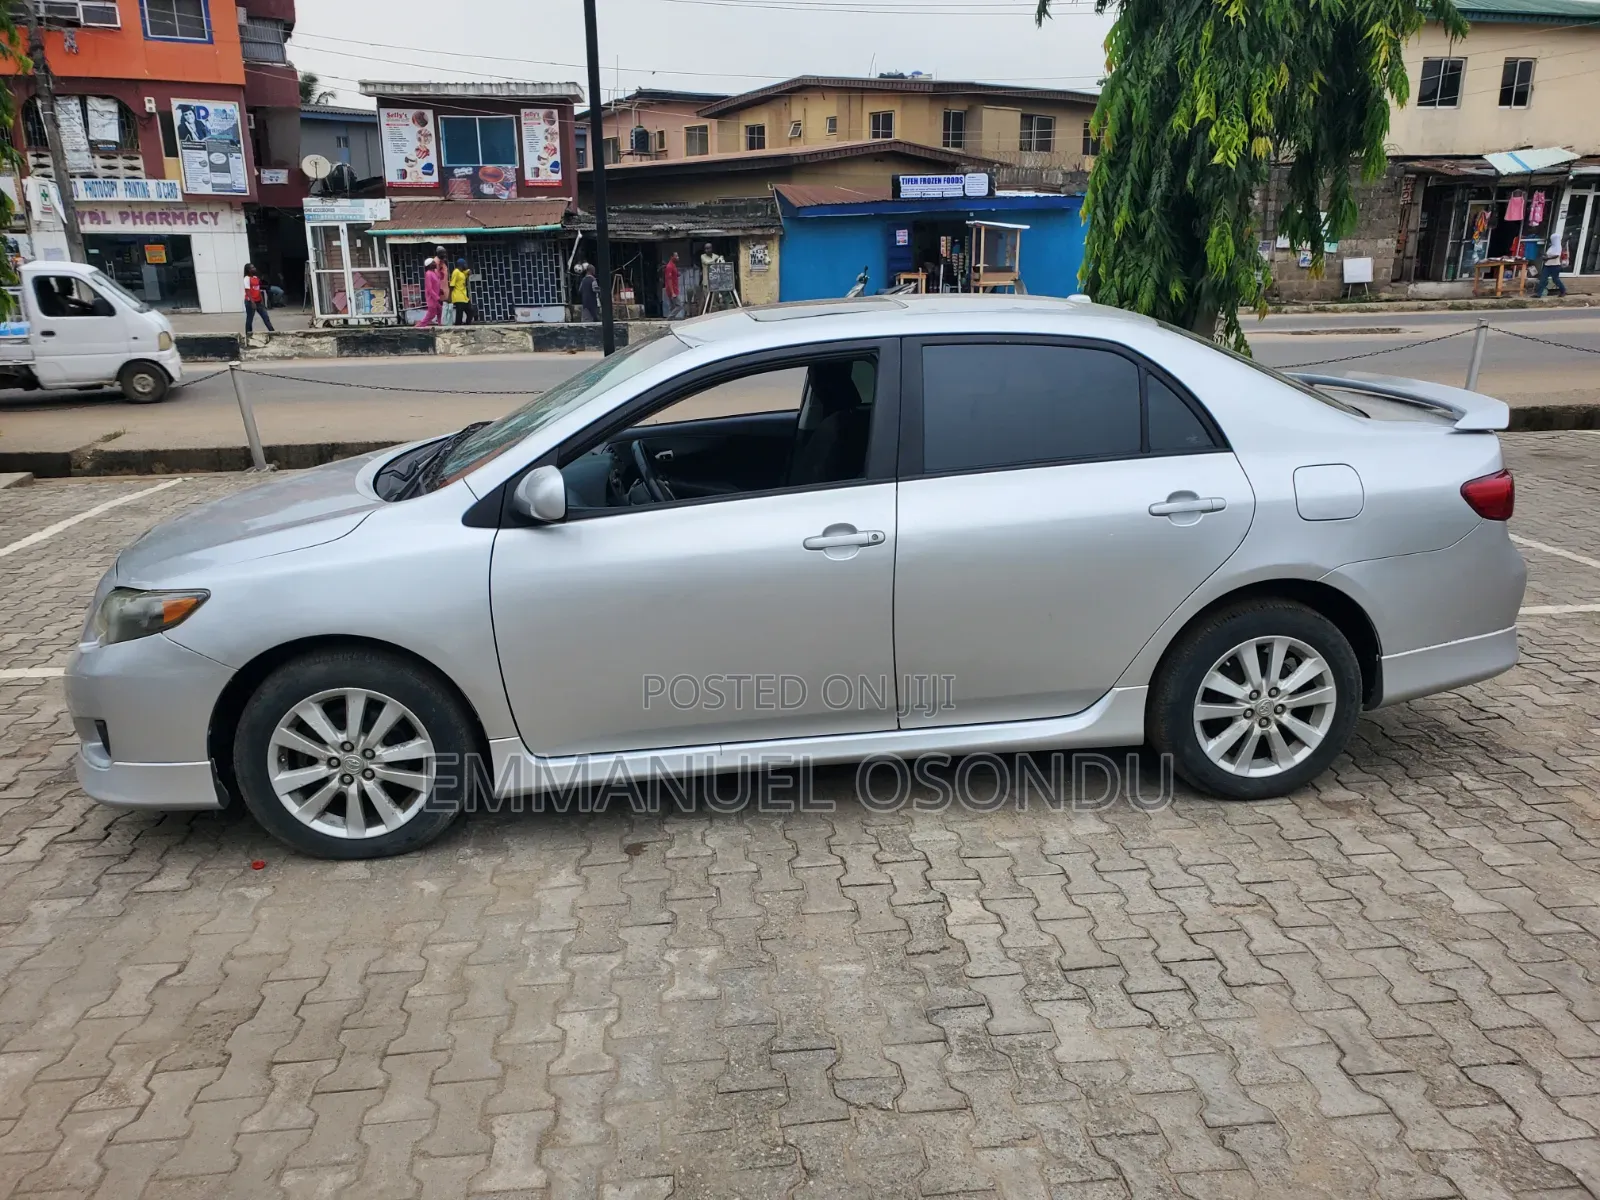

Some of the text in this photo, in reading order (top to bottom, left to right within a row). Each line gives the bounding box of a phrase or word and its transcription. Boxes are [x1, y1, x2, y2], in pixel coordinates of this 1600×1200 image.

[919, 177, 942, 185] FROZEN
[943, 176, 964, 185] FOODS
[83, 180, 119, 199] PHOTOCOPY
[123, 181, 151, 199] PRINTING
[76, 210, 220, 226] YAL PHARMACY
